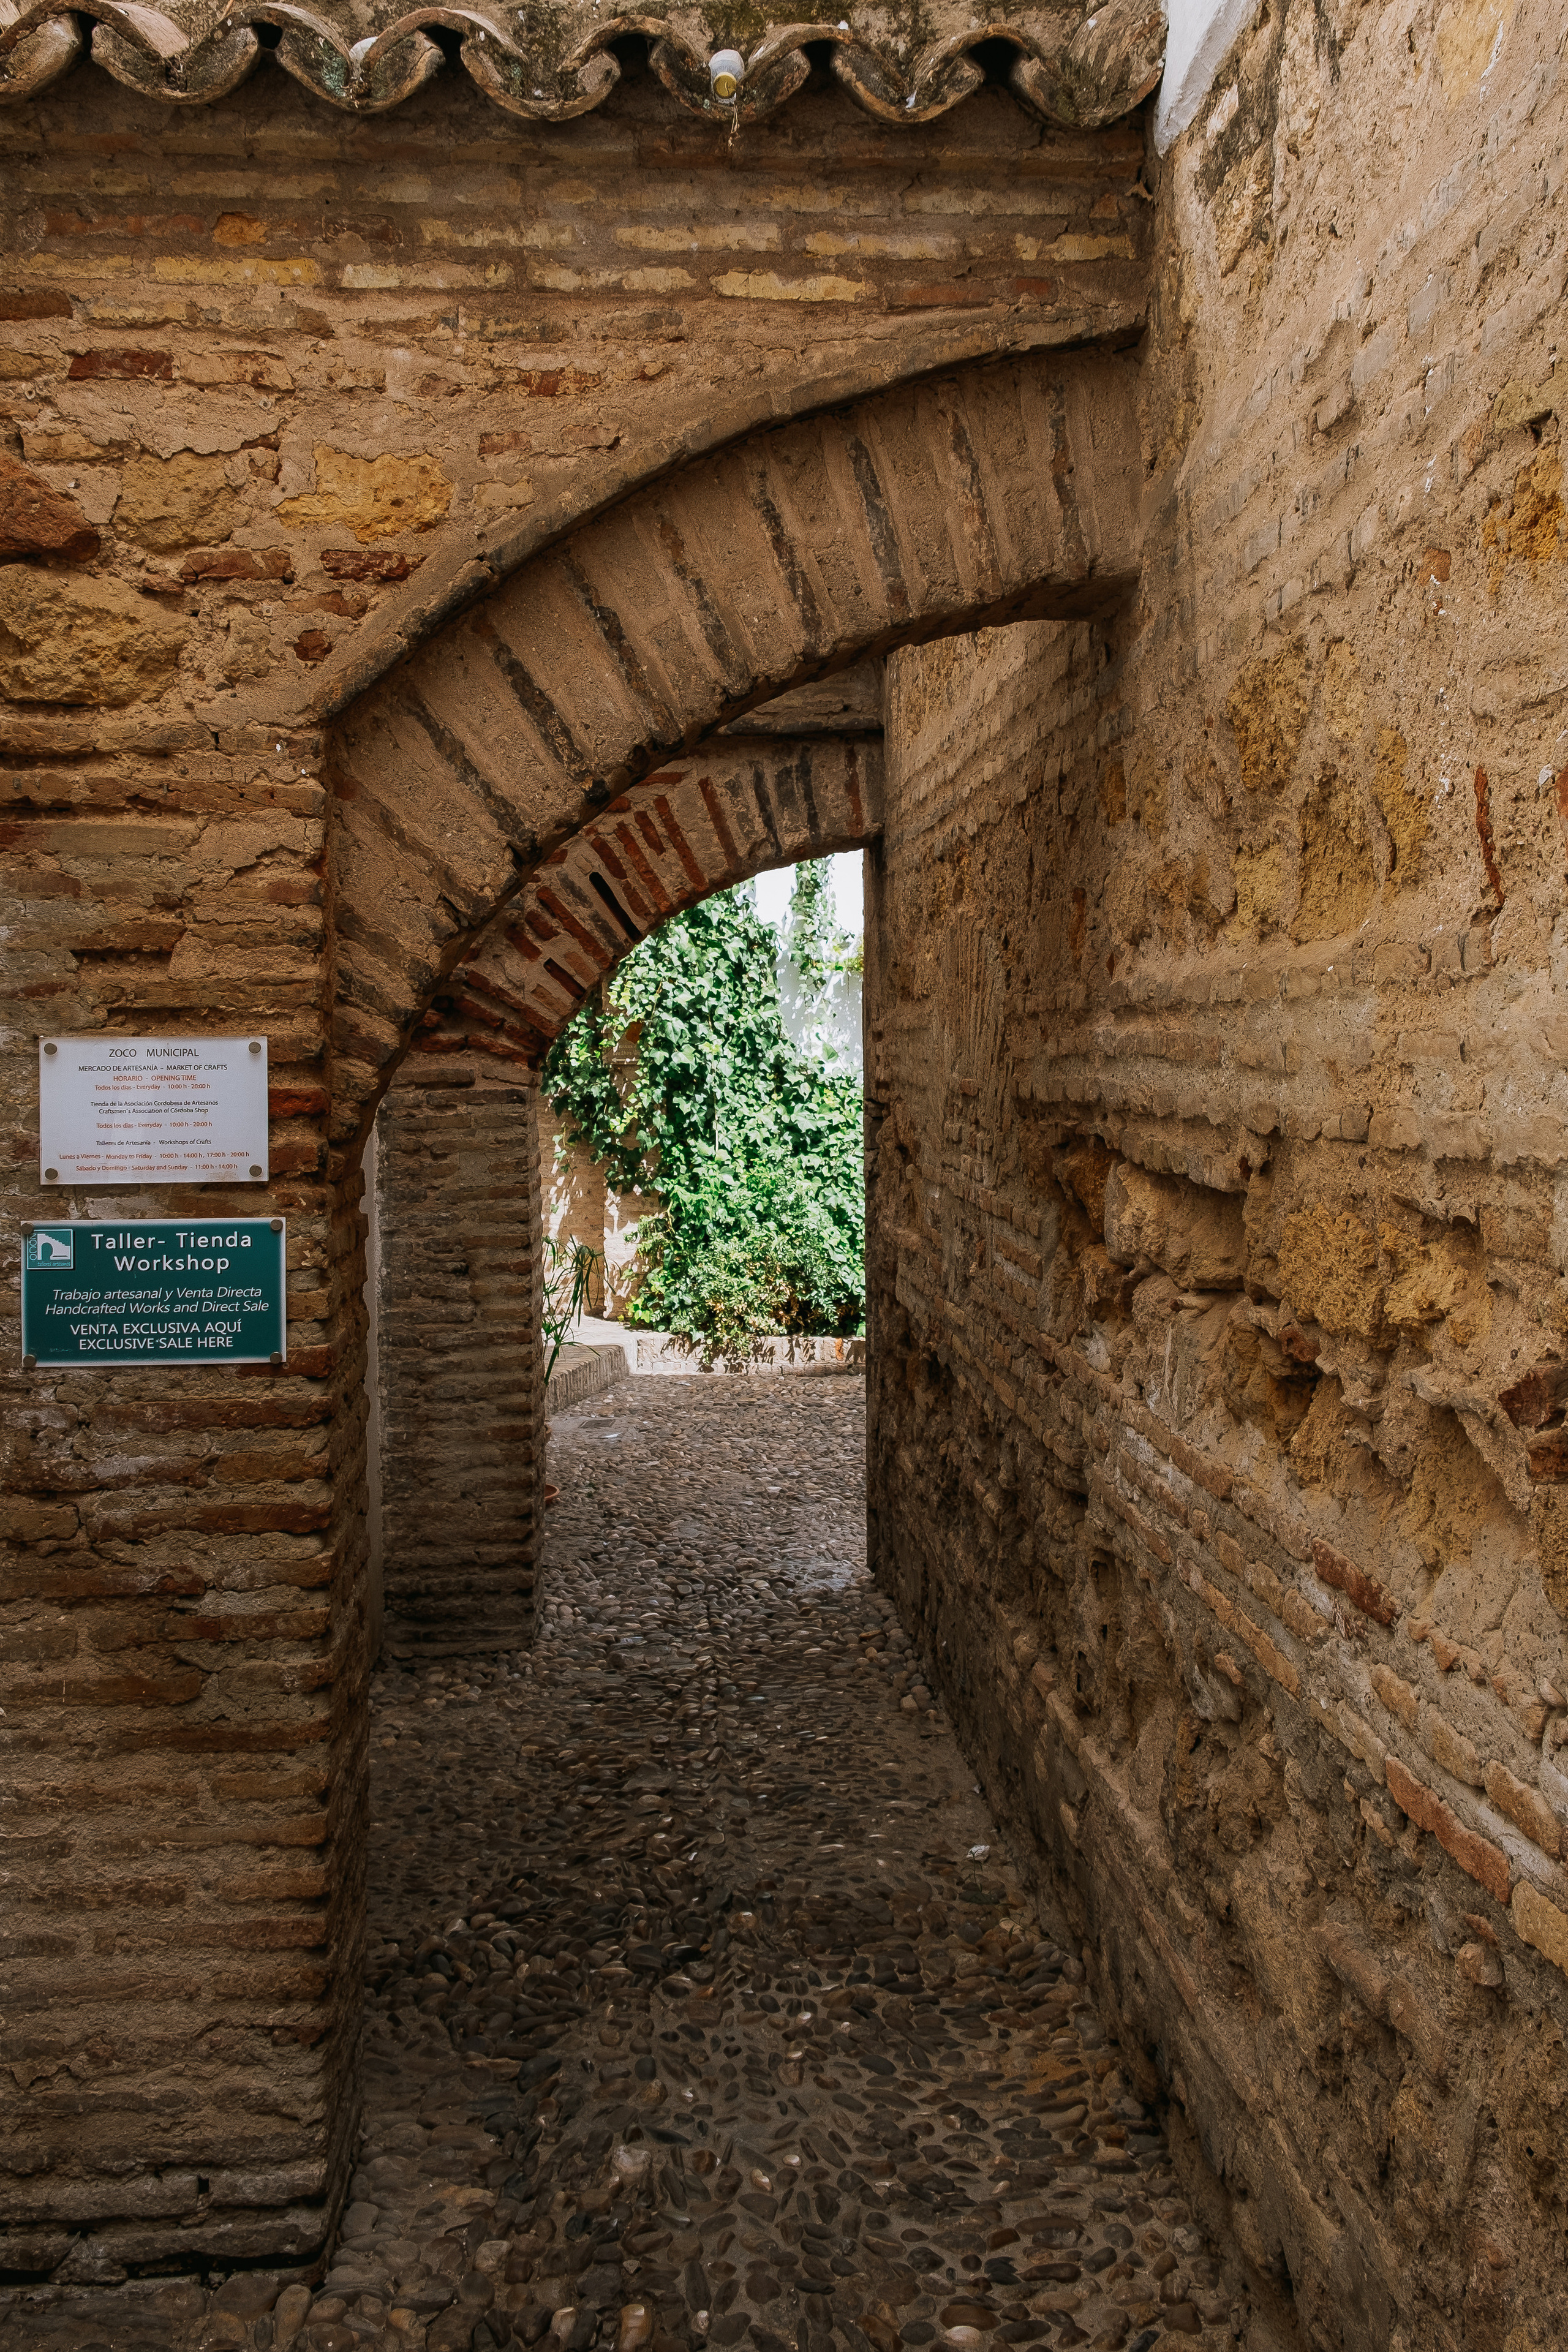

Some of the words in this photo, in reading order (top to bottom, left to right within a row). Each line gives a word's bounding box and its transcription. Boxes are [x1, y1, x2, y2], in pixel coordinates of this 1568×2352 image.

[175, 1231, 252, 1248] Tienda
[114, 1254, 229, 1274] Workshop
[53, 1289, 101, 1303] Trabajo
[104, 1287, 162, 1299] artesanal
[164, 1290, 173, 1302] y
[177, 1287, 213, 1298] Venta
[217, 1286, 262, 1298] Directa
[45, 1303, 126, 1315] Handcrafted
[130, 1302, 170, 1313] Works
[173, 1301, 199, 1313] and
[202, 1301, 240, 1312] Direct
[243, 1300, 269, 1312] Sale
[70, 1324, 118, 1335] VENTA
[123, 1322, 200, 1334] EXCLUSIVA
[205, 1319, 242, 1335] AQUÍ
[79, 1338, 154, 1350] EXCLUSIVE
[159, 1337, 192, 1348] SALE
[197, 1336, 233, 1348] HERE
